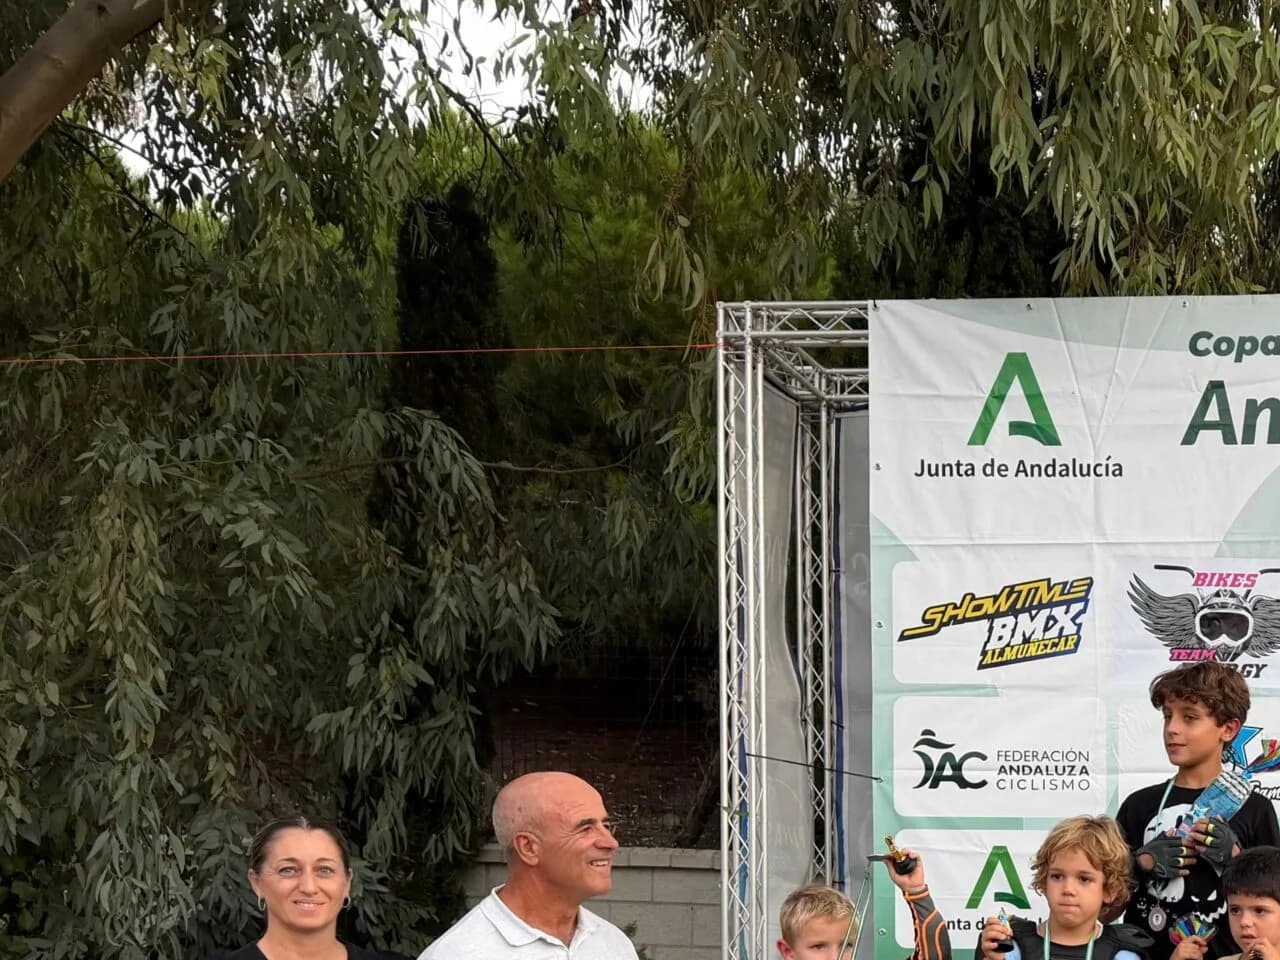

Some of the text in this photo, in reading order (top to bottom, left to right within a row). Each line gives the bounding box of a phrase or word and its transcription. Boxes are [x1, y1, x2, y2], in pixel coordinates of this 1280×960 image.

[914, 455, 1124, 479] Junta de Andalucía
[1191, 571, 1259, 588] BIKES
[900, 577, 1093, 641] SHOWTIME
[984, 602, 1087, 651] BMX
[1169, 647, 1216, 662] TEAM
[996, 748, 1090, 762] FEDERACIÓN
[997, 764, 1090, 777] ANDALUZA
[996, 778, 1090, 791] CICLISMO
[946, 918, 972, 931] nta
